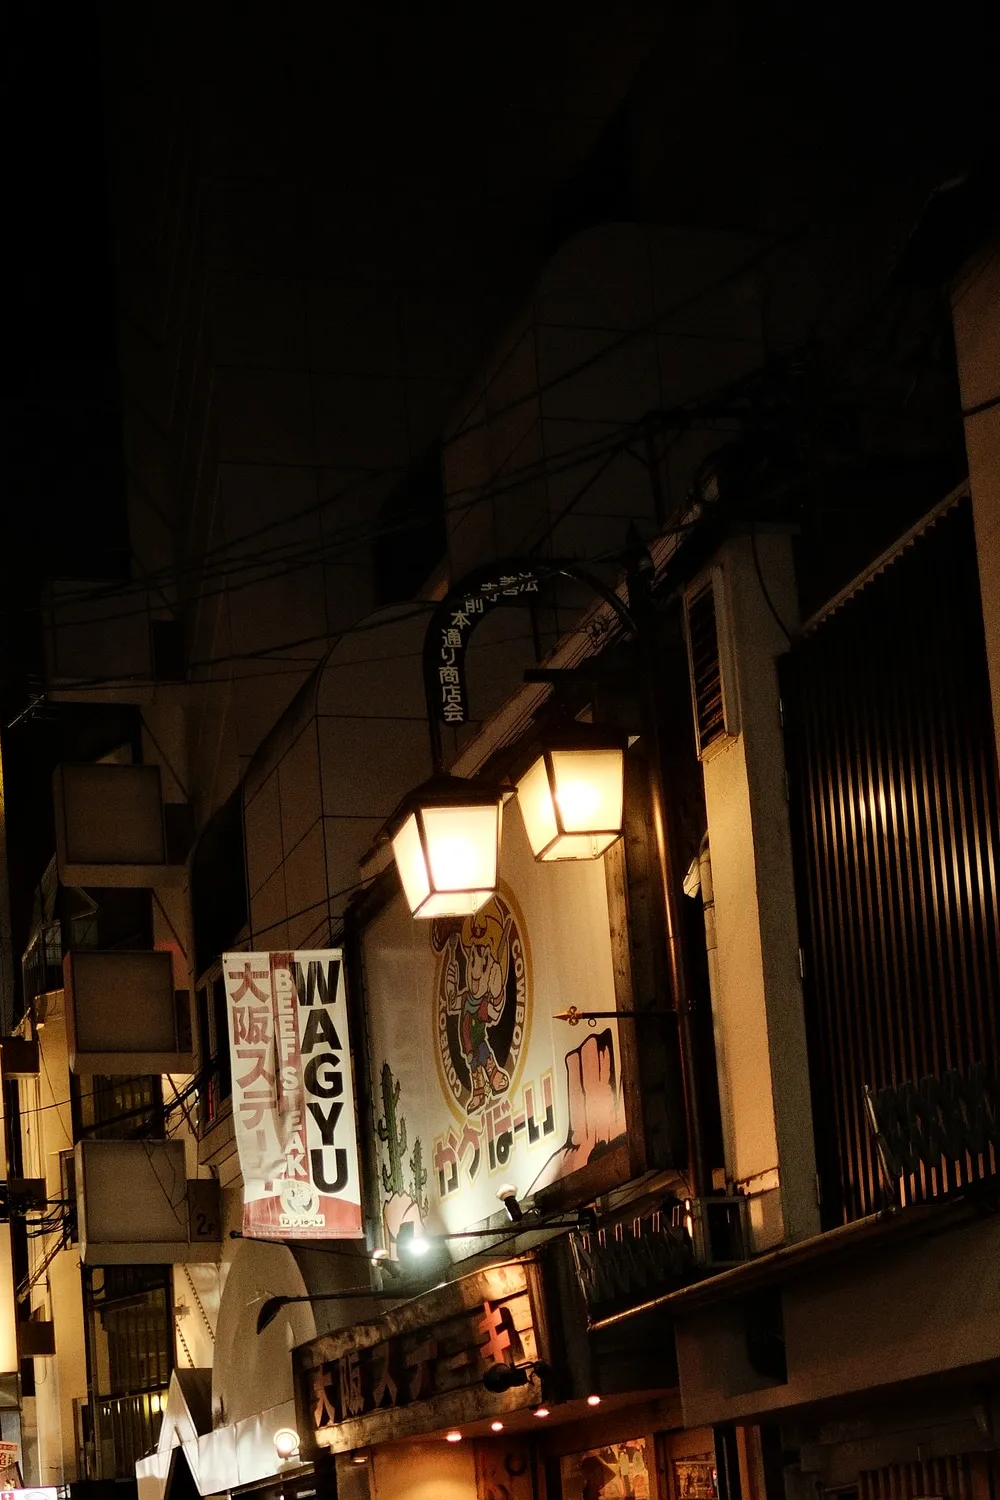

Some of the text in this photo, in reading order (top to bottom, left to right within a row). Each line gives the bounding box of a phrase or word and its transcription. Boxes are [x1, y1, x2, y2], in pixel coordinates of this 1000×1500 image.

[511, 939, 526, 1066] COWBOY
[228, 962, 277, 1193] 大阪ステー
[289, 960, 350, 1194] WAGYU
[435, 1077, 555, 1198] かうぼーい
[313, 1301, 512, 1428] 大阪ステーキ
